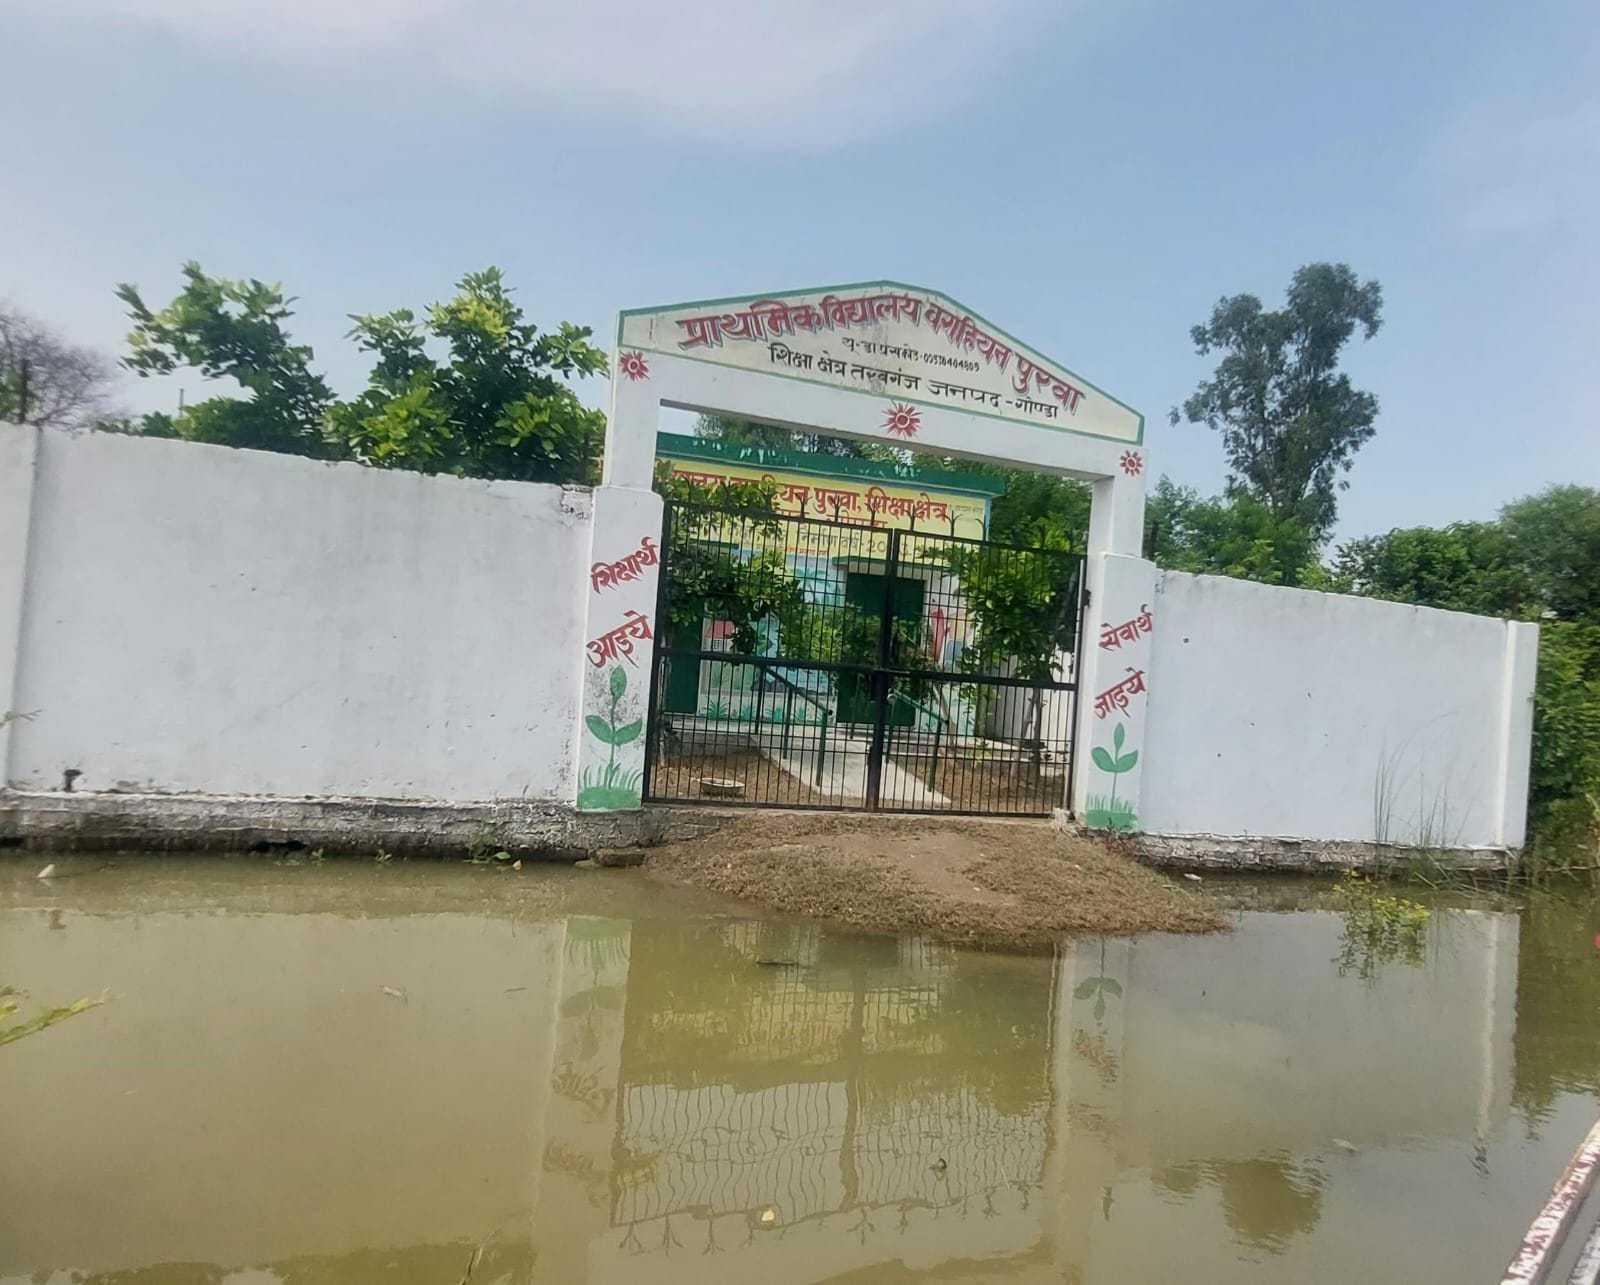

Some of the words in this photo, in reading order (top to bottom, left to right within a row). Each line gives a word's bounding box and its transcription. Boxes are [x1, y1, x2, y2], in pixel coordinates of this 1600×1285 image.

[676, 300, 822, 350] प्राथमिक
[820, 294, 922, 331] विद्यालय
[1012, 351, 1087, 415] पुरवा
[769, 342, 813, 369] शिक्षा
[817, 351, 848, 377] क्षेत्र
[928, 379, 1002, 408] जनपद
[586, 609, 654, 669] आइये
[1098, 603, 1153, 652] सेवार्थ
[1094, 666, 1146, 720] जाइये
